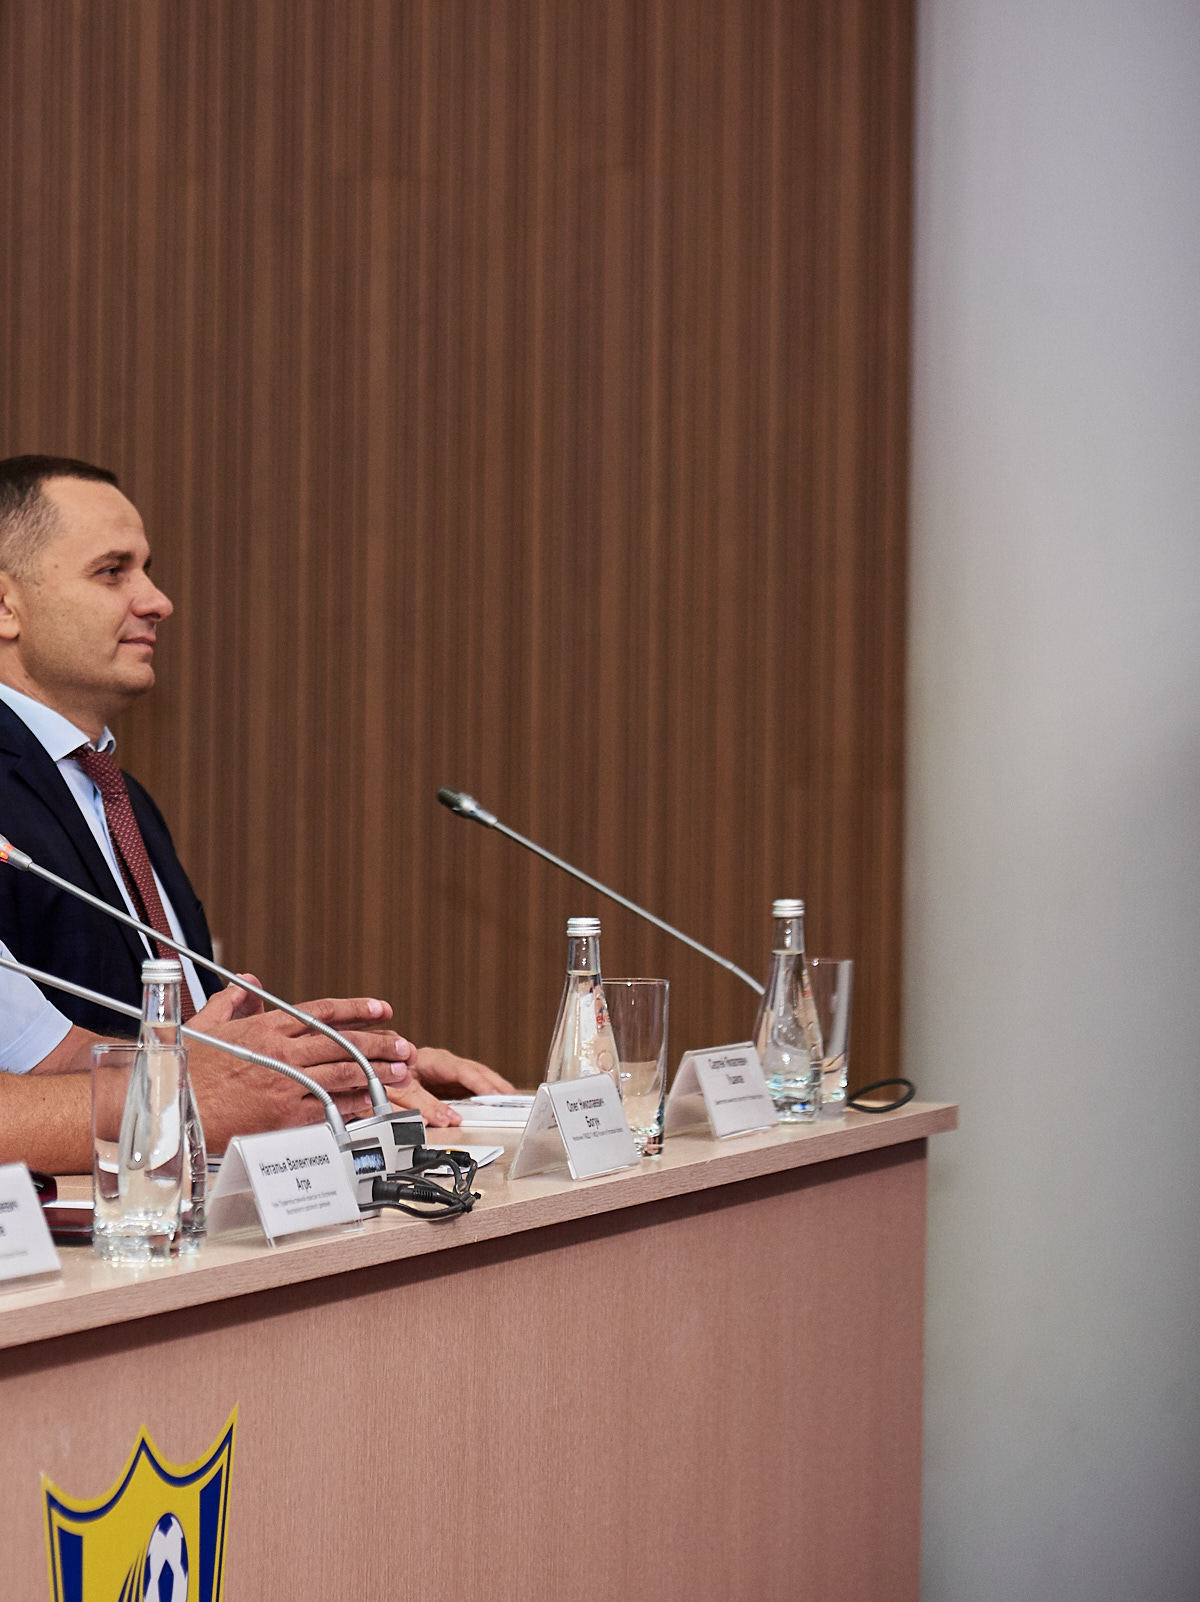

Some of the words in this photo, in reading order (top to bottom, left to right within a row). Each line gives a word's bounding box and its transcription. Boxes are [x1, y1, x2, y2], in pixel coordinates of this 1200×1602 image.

[566, 1100, 579, 1113] Олег
[585, 1115, 601, 1130] Богун
[259, 1162, 287, 1177] Наталья
[286, 1153, 331, 1172] Валентиновна
[295, 1177, 312, 1193] Агре
